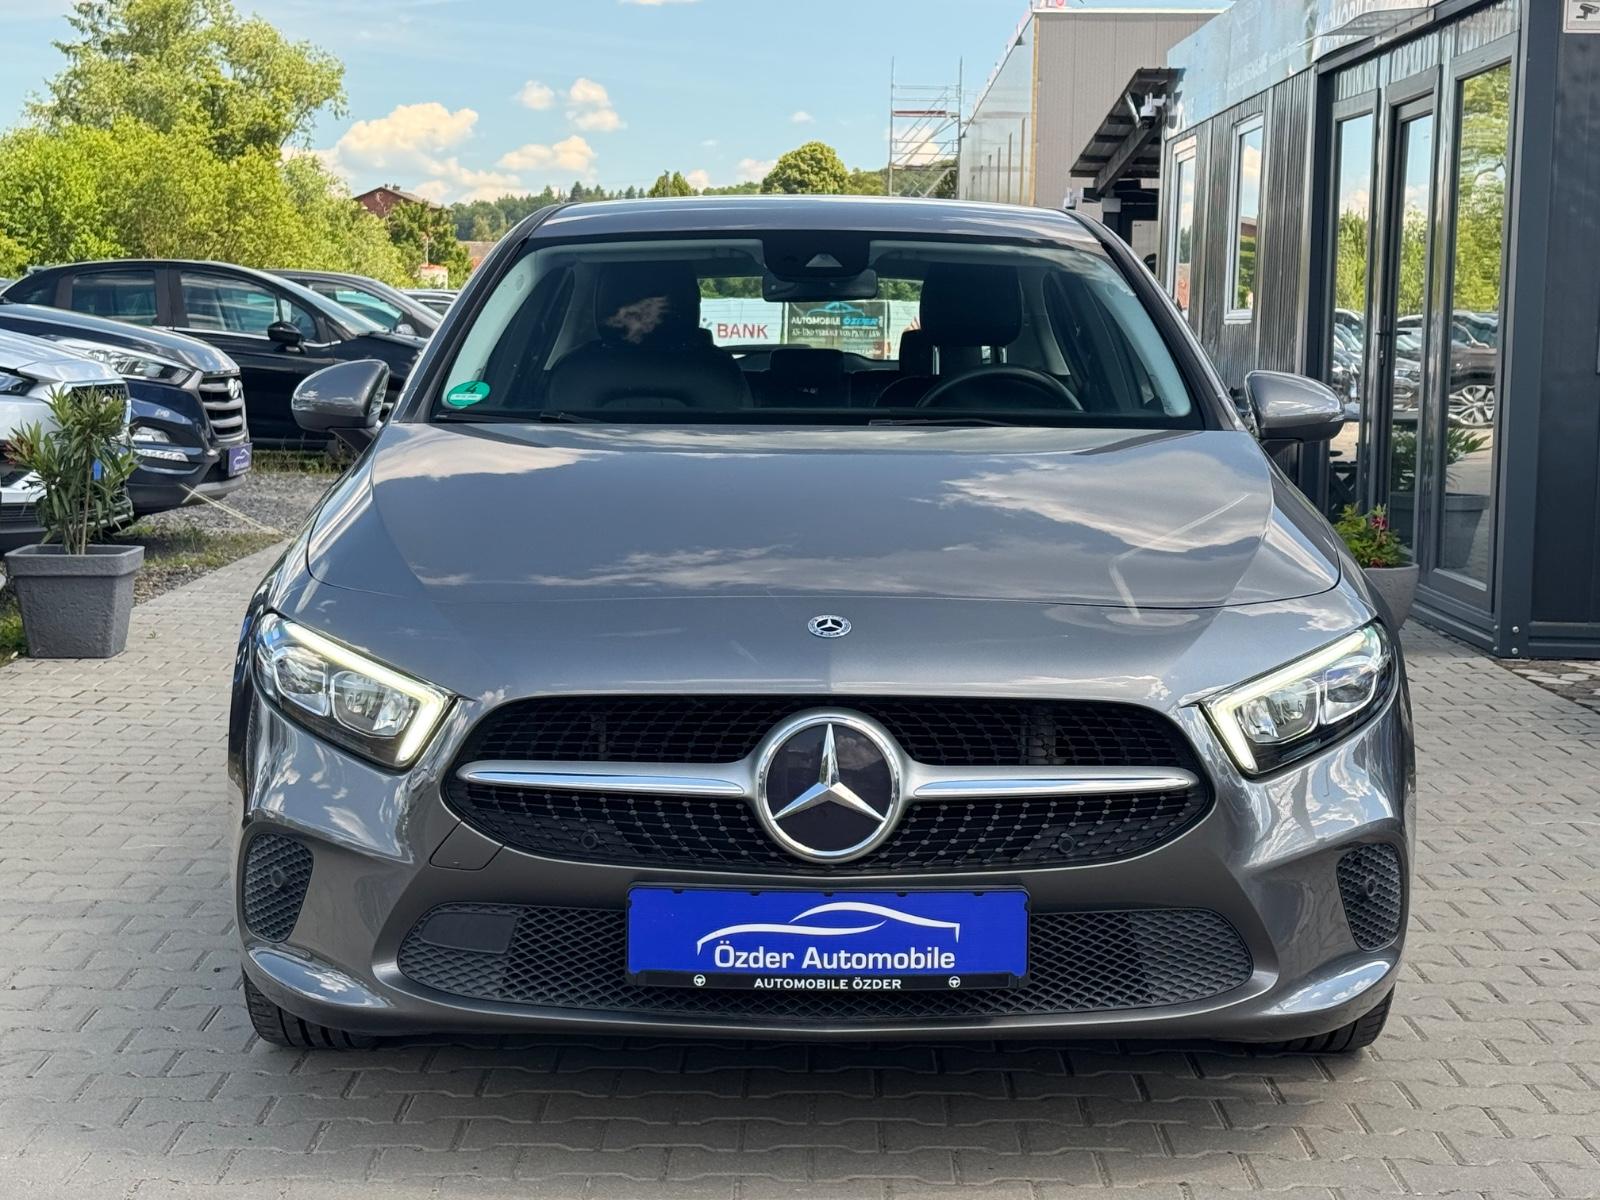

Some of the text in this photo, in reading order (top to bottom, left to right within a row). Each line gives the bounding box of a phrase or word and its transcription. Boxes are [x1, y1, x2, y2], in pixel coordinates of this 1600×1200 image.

[791, 316, 840, 325] AUTOMOBILE
[717, 323, 769, 340] BANK
[465, 382, 478, 393] 4
[714, 940, 956, 970] Özder Automobile
[754, 977, 902, 990] AUTOMOBILE ÖZDER
